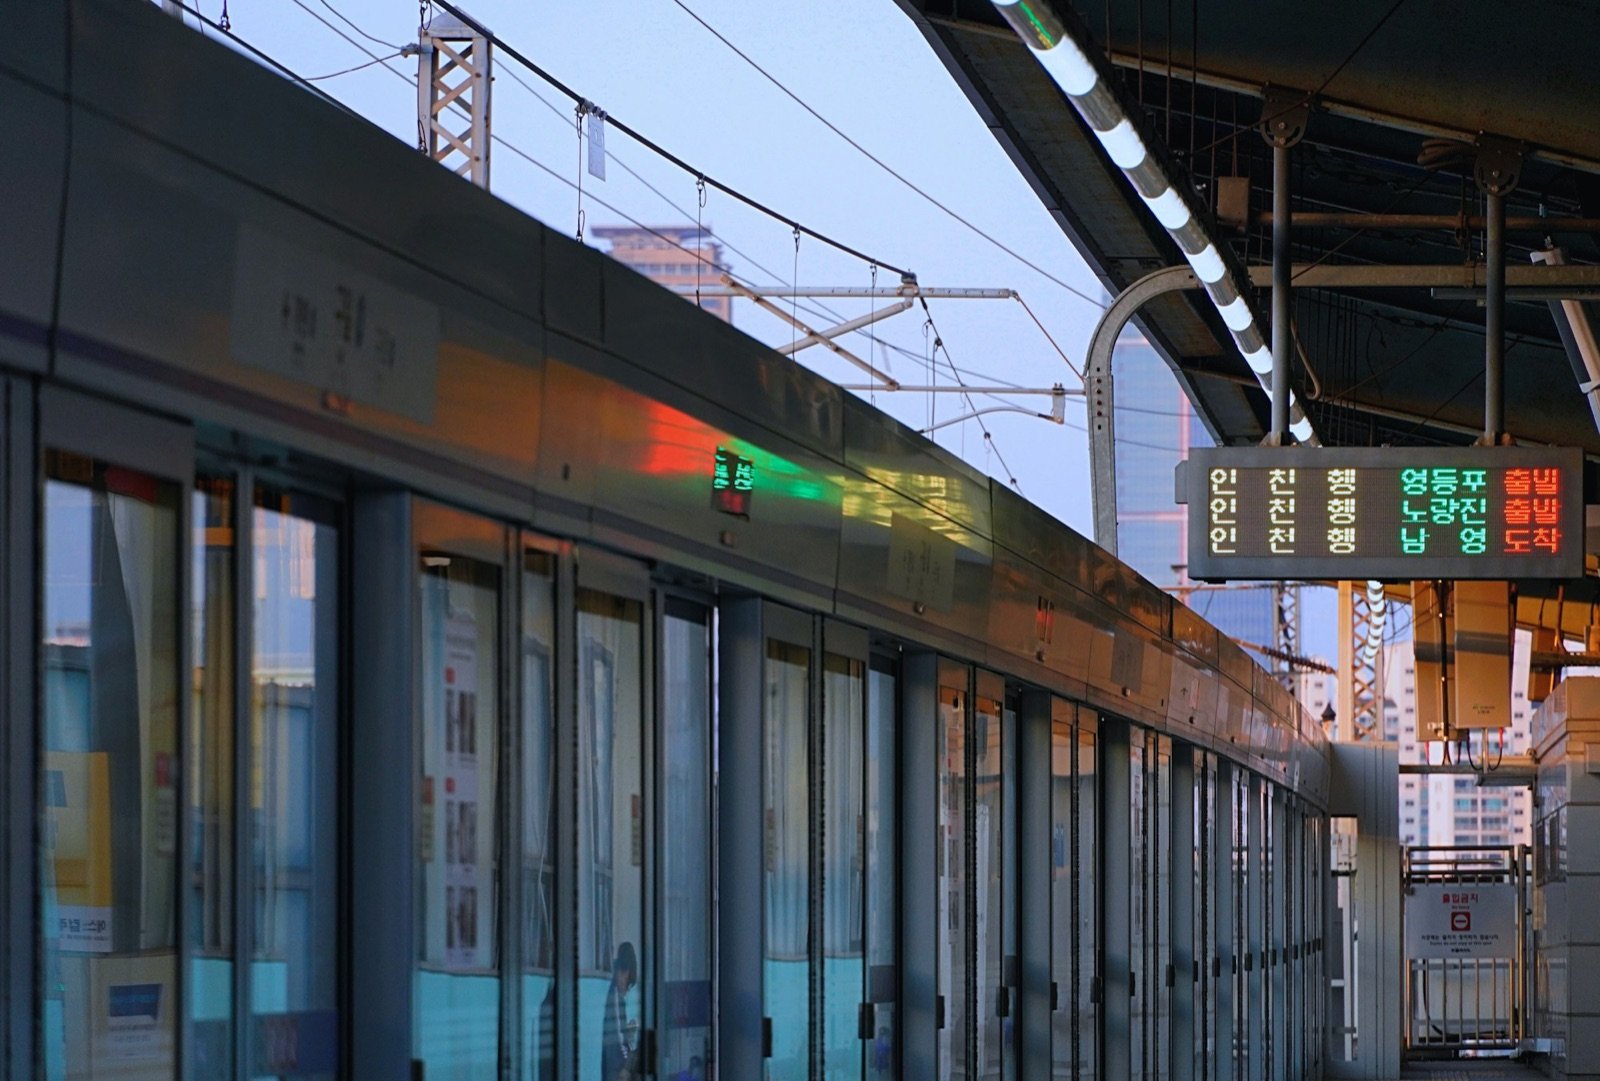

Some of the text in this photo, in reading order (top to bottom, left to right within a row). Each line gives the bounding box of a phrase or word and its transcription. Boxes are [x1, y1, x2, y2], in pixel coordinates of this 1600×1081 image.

[1401, 468, 1488, 495] 영등포
[1402, 497, 1488, 525] 노량진
[1503, 526, 1563, 554] 도착
